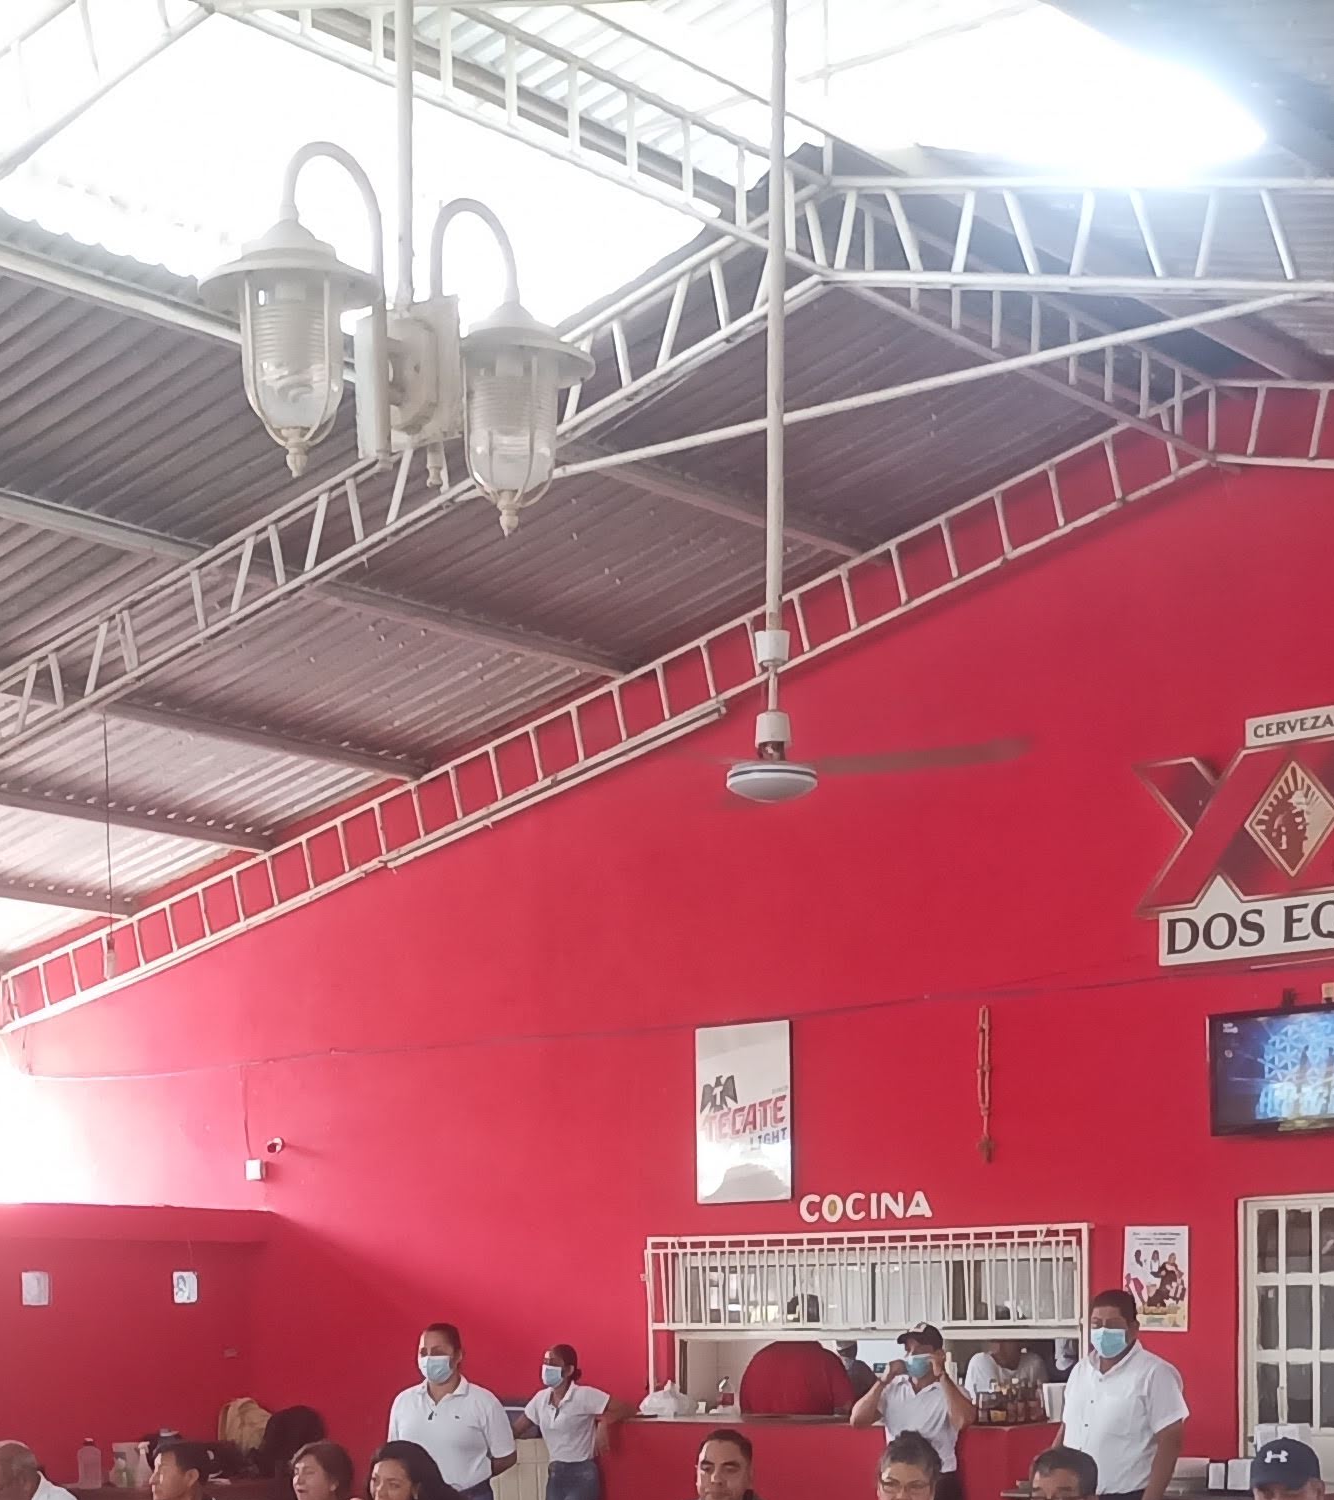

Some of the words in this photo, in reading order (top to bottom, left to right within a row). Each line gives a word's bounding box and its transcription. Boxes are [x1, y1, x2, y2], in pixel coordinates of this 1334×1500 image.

[1253, 714, 1334, 739] CERVEZA
[1167, 908, 1266, 955] DOS
[705, 1094, 787, 1142] TECATE
[750, 1127, 788, 1151] LIGHT
[799, 1190, 933, 1223] COCINA
